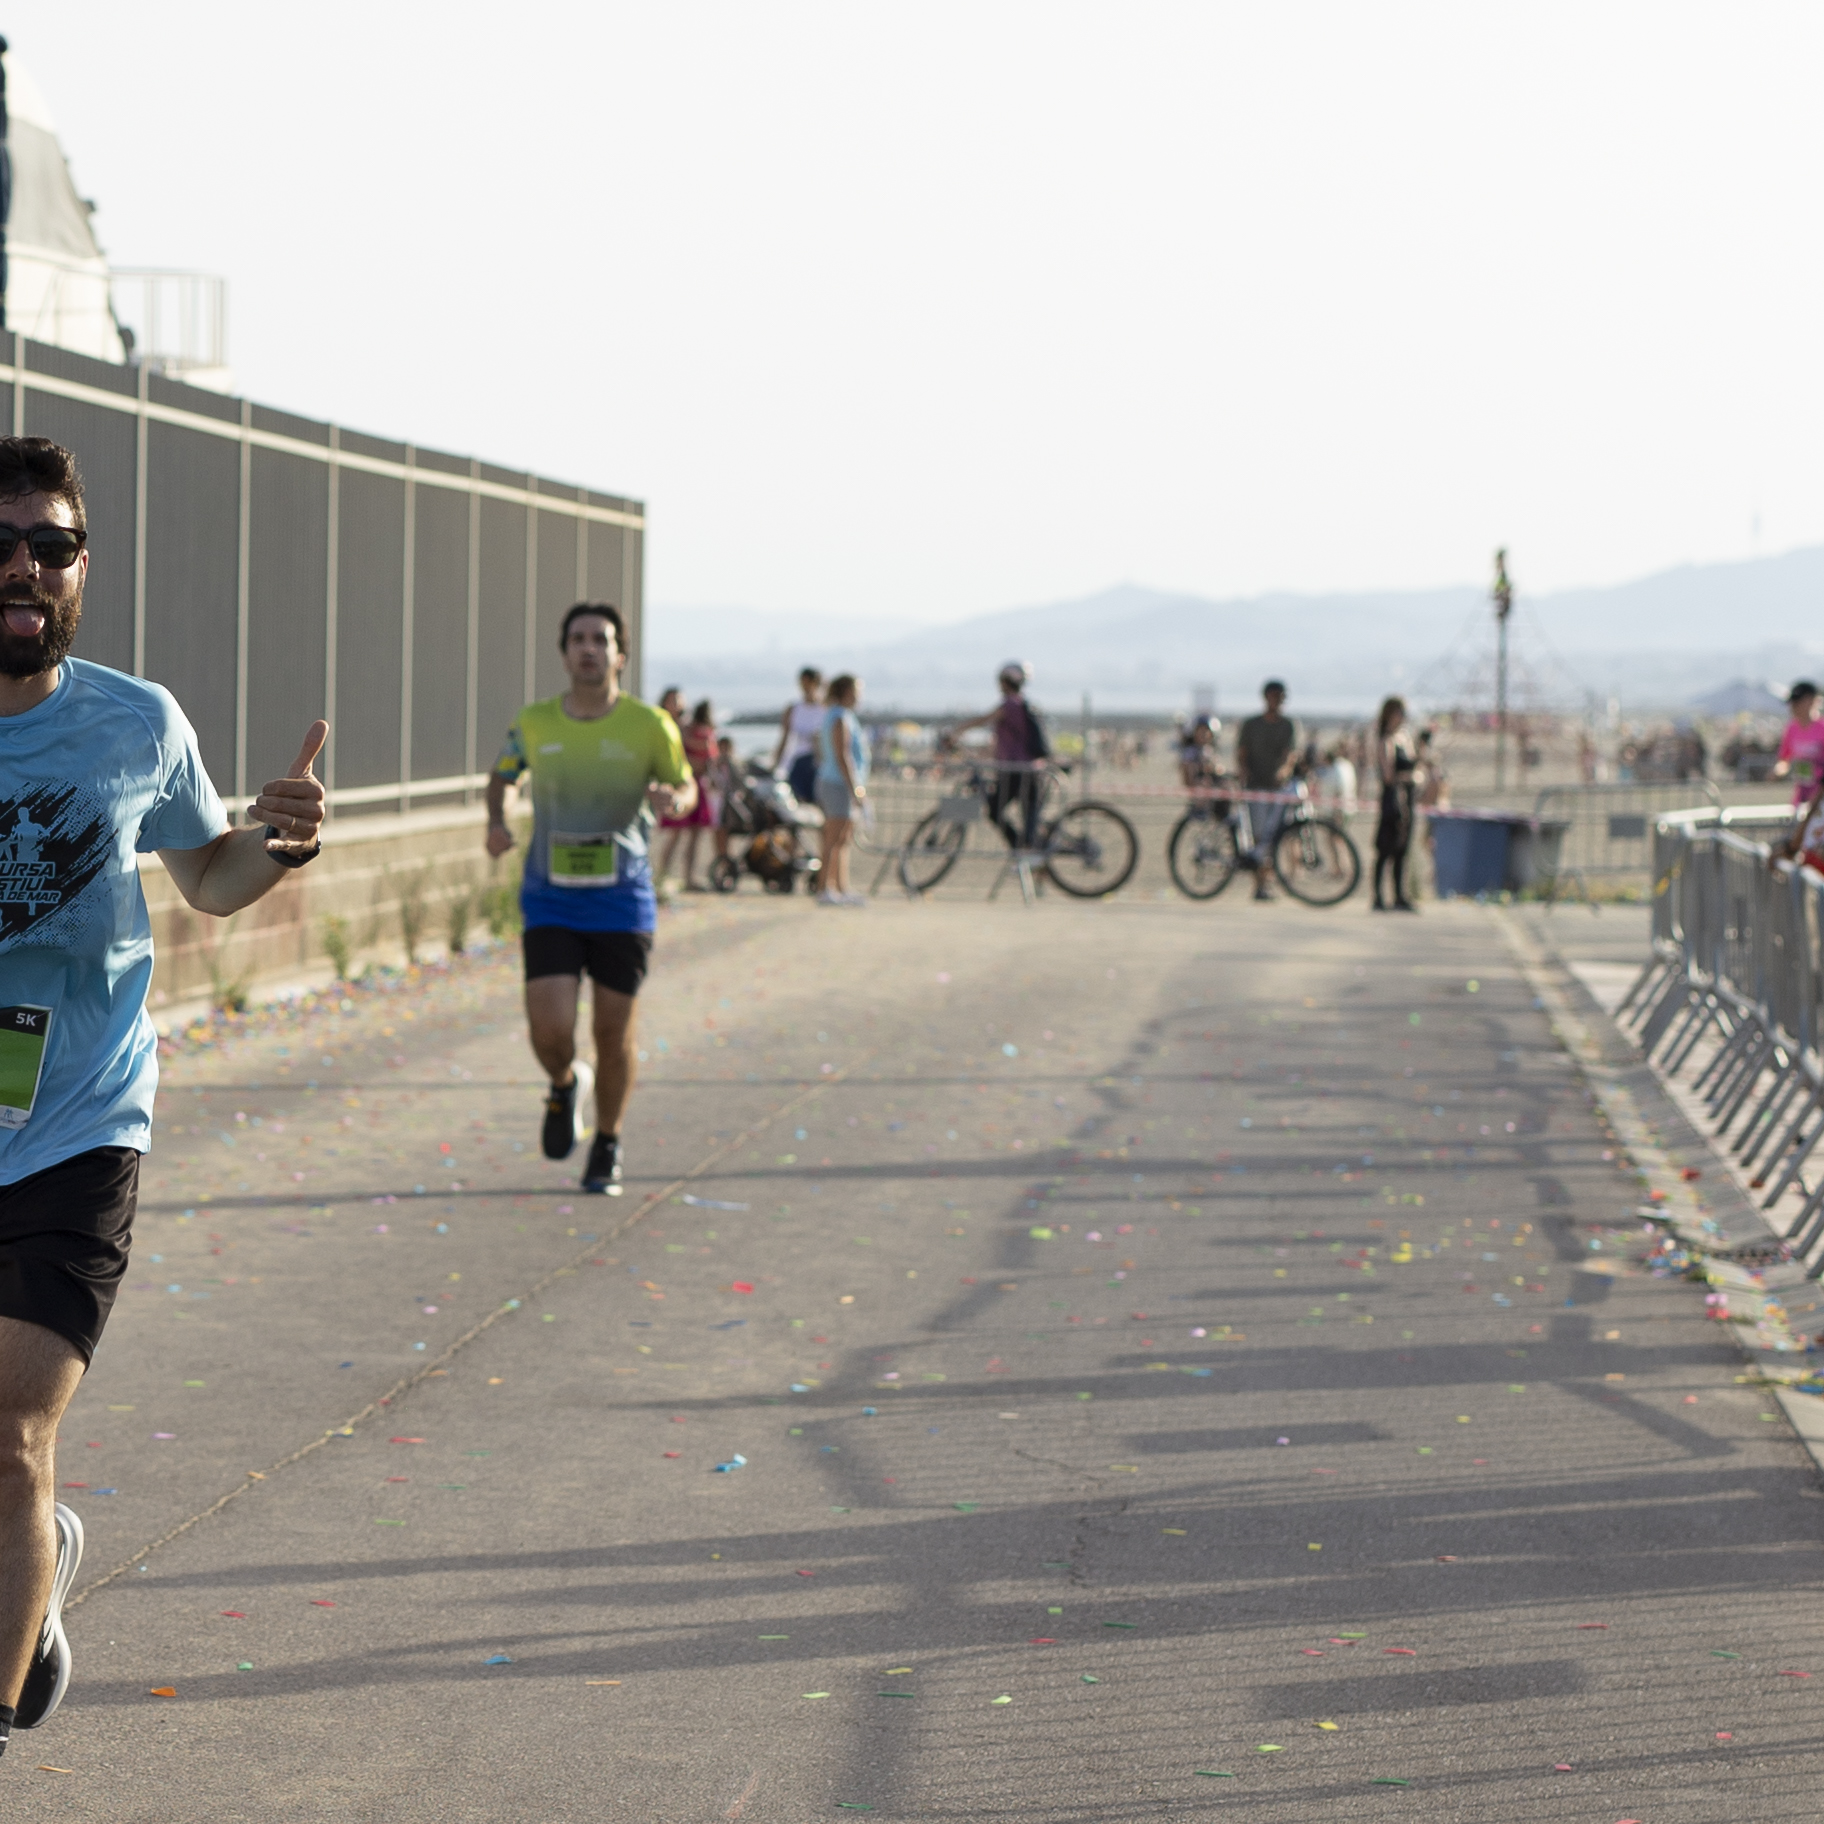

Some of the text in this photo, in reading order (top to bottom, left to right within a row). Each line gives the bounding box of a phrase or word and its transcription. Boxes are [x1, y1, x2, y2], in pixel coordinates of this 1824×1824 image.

[7, 891, 28, 901] DE
[28, 891, 60, 902] MAR
[15, 1012, 37, 1027] 5K
